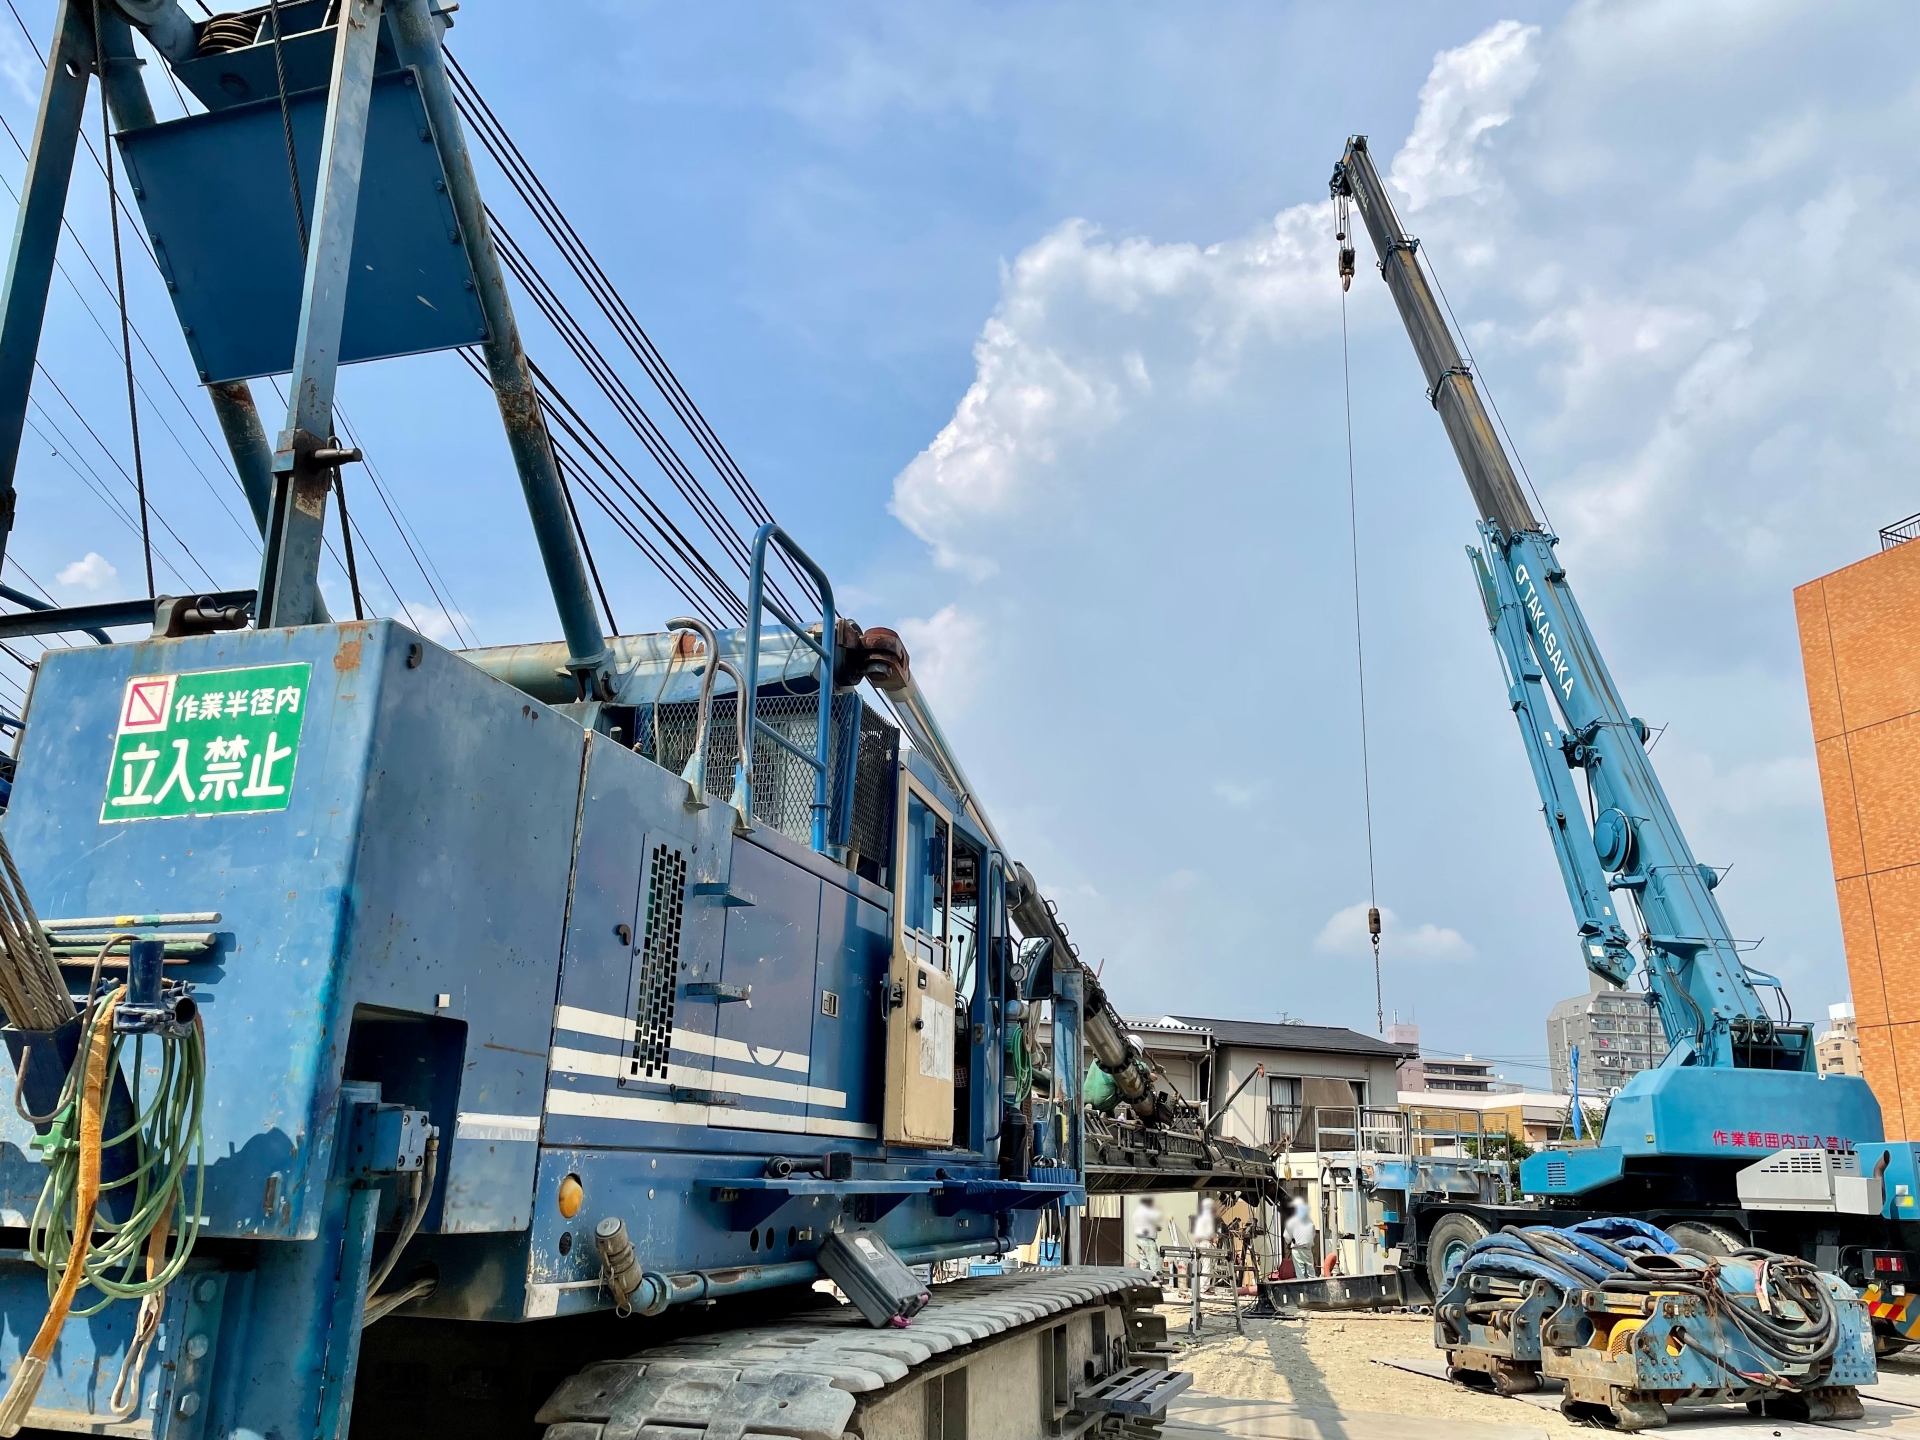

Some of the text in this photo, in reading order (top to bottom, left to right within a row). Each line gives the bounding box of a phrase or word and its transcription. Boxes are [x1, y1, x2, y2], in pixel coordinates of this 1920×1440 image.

[1524, 580, 1574, 701] TAKASAKA
[175, 685, 301, 722] 作業半径内
[111, 731, 292, 806] 立入禁止
[1712, 1130, 1852, 1150] 作業範囲内立入禁止
